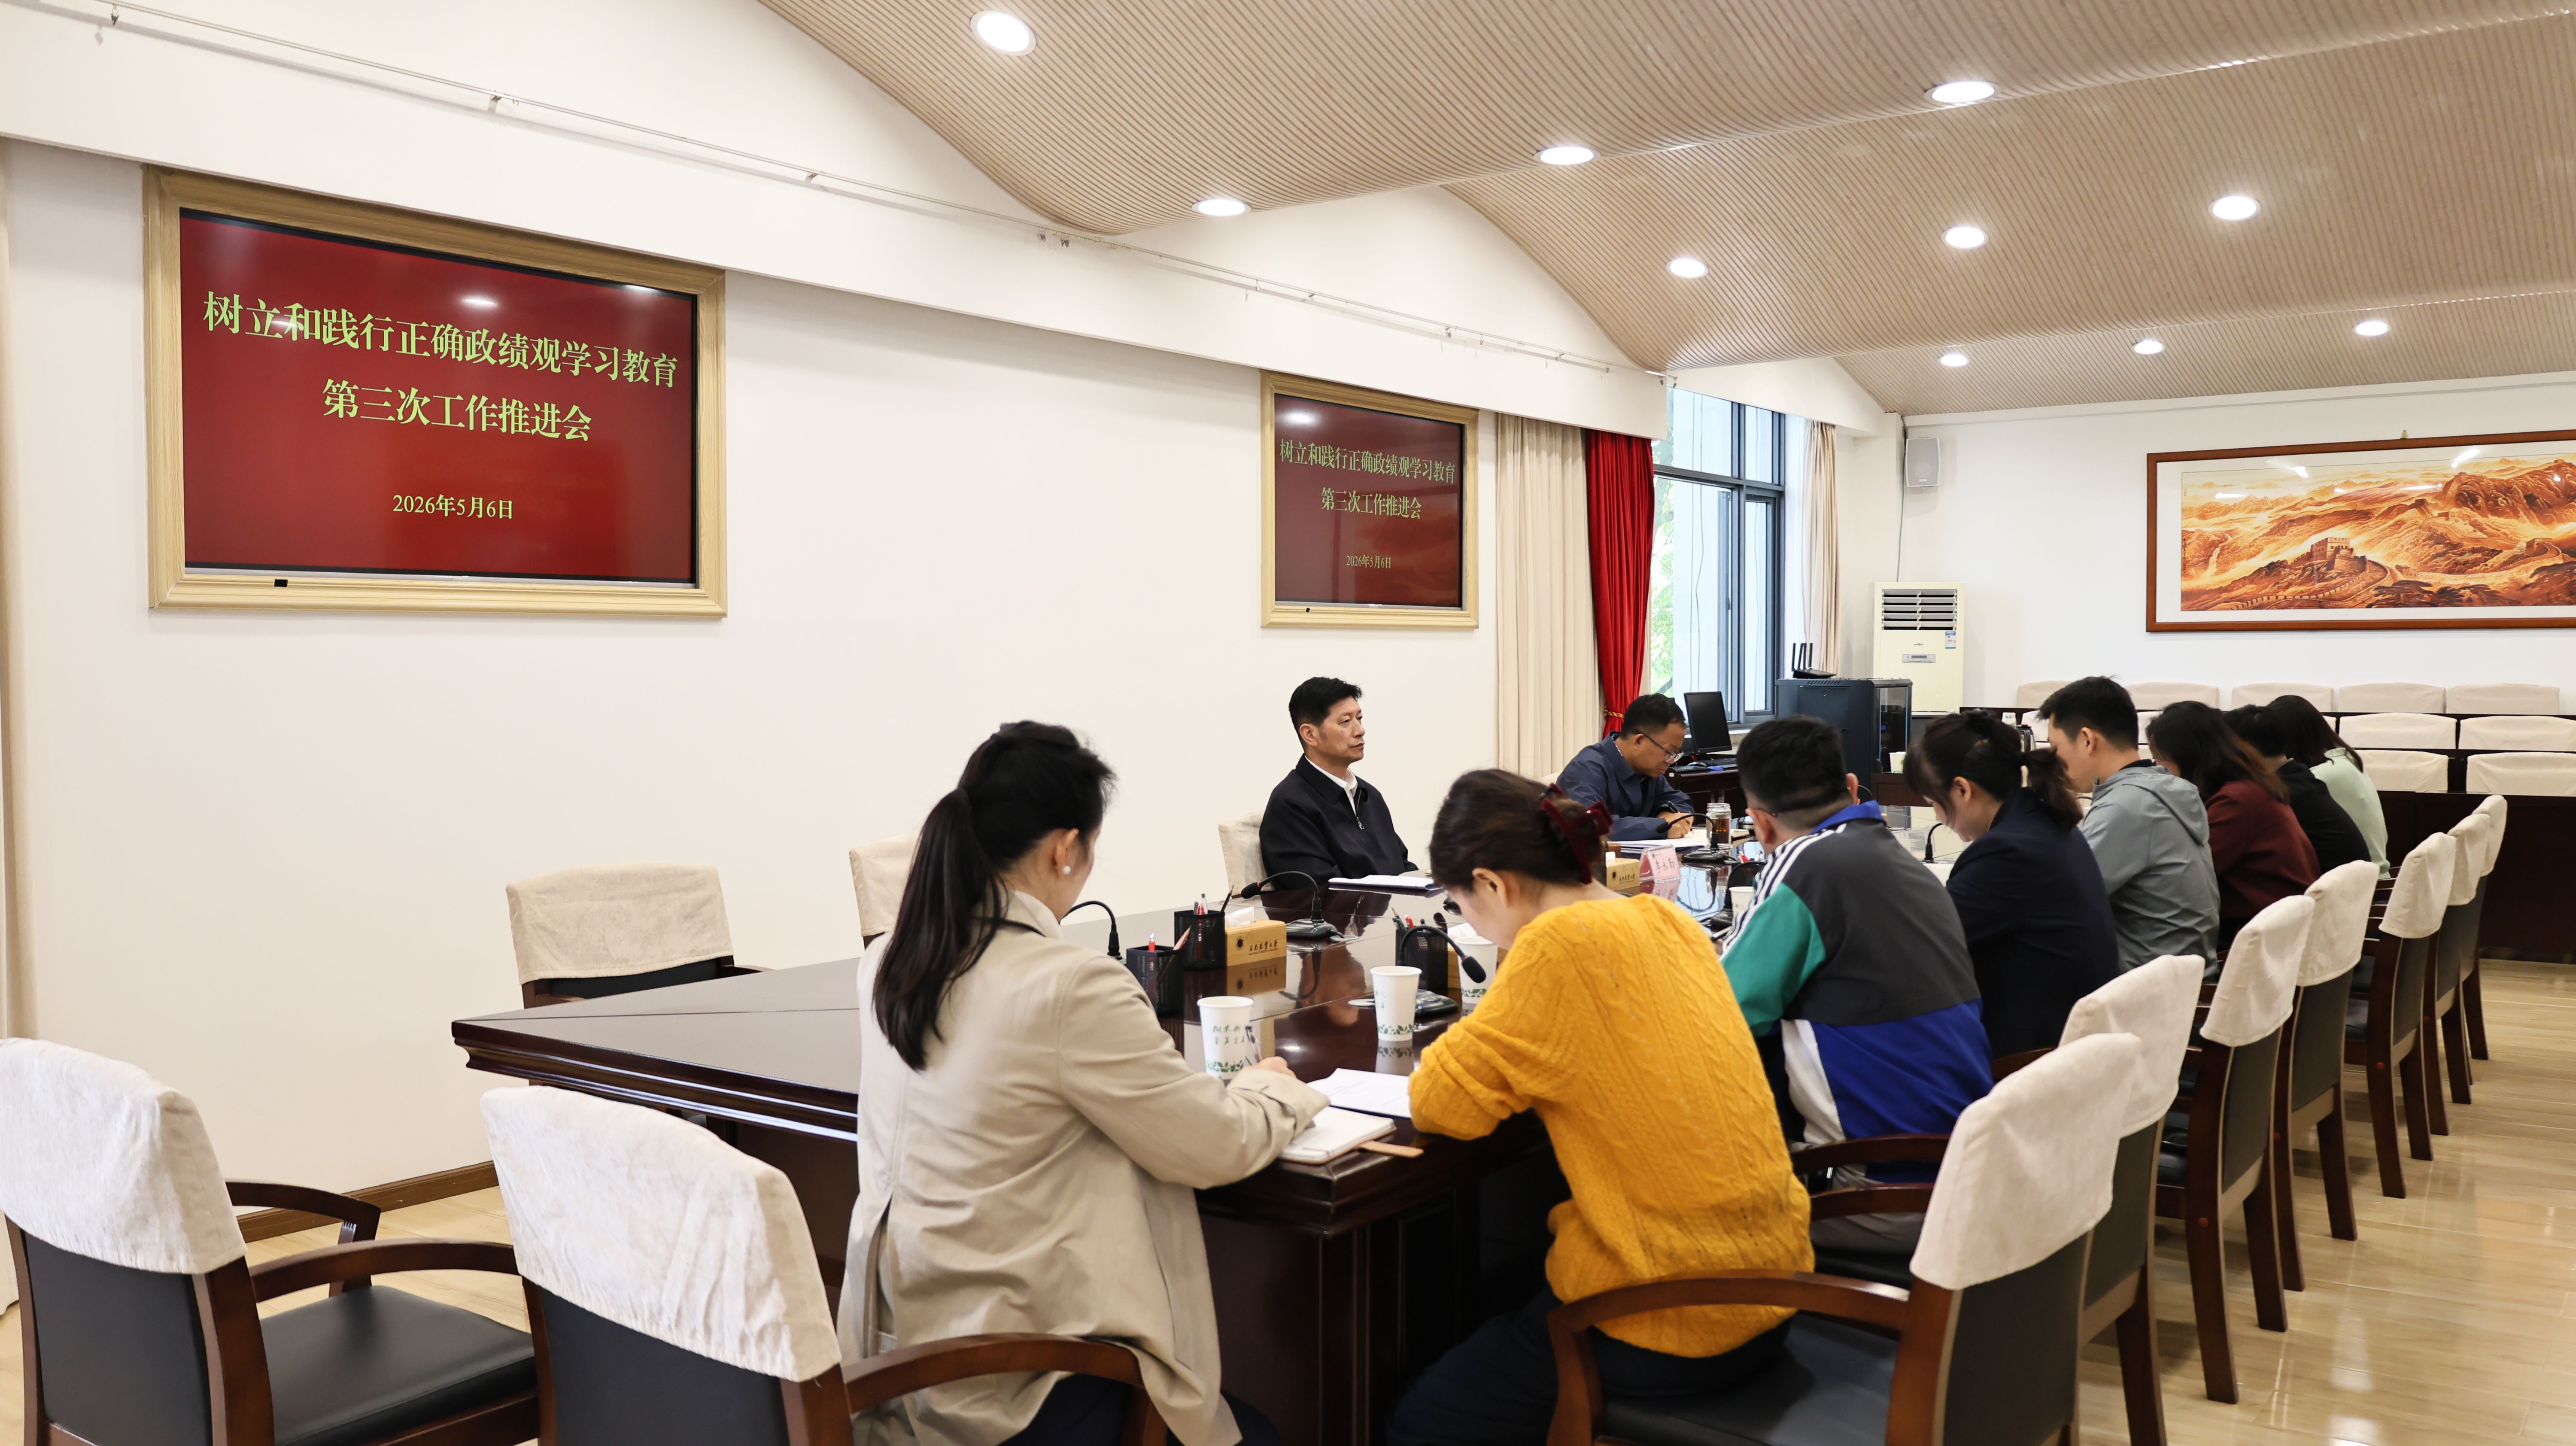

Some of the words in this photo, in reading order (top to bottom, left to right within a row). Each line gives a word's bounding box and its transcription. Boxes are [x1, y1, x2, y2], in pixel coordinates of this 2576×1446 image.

[204, 291, 678, 388] 树立和践行正确政绩观学习教育
[323, 379, 592, 441] 第三次工作推进会
[1280, 438, 1455, 484] 树立和践行正确政绩观学习教育
[393, 493, 513, 519] 2026年5月6日
[1321, 487, 1422, 519] 第三次工作推进会
[1346, 554, 1391, 569] 2026年5月6日
